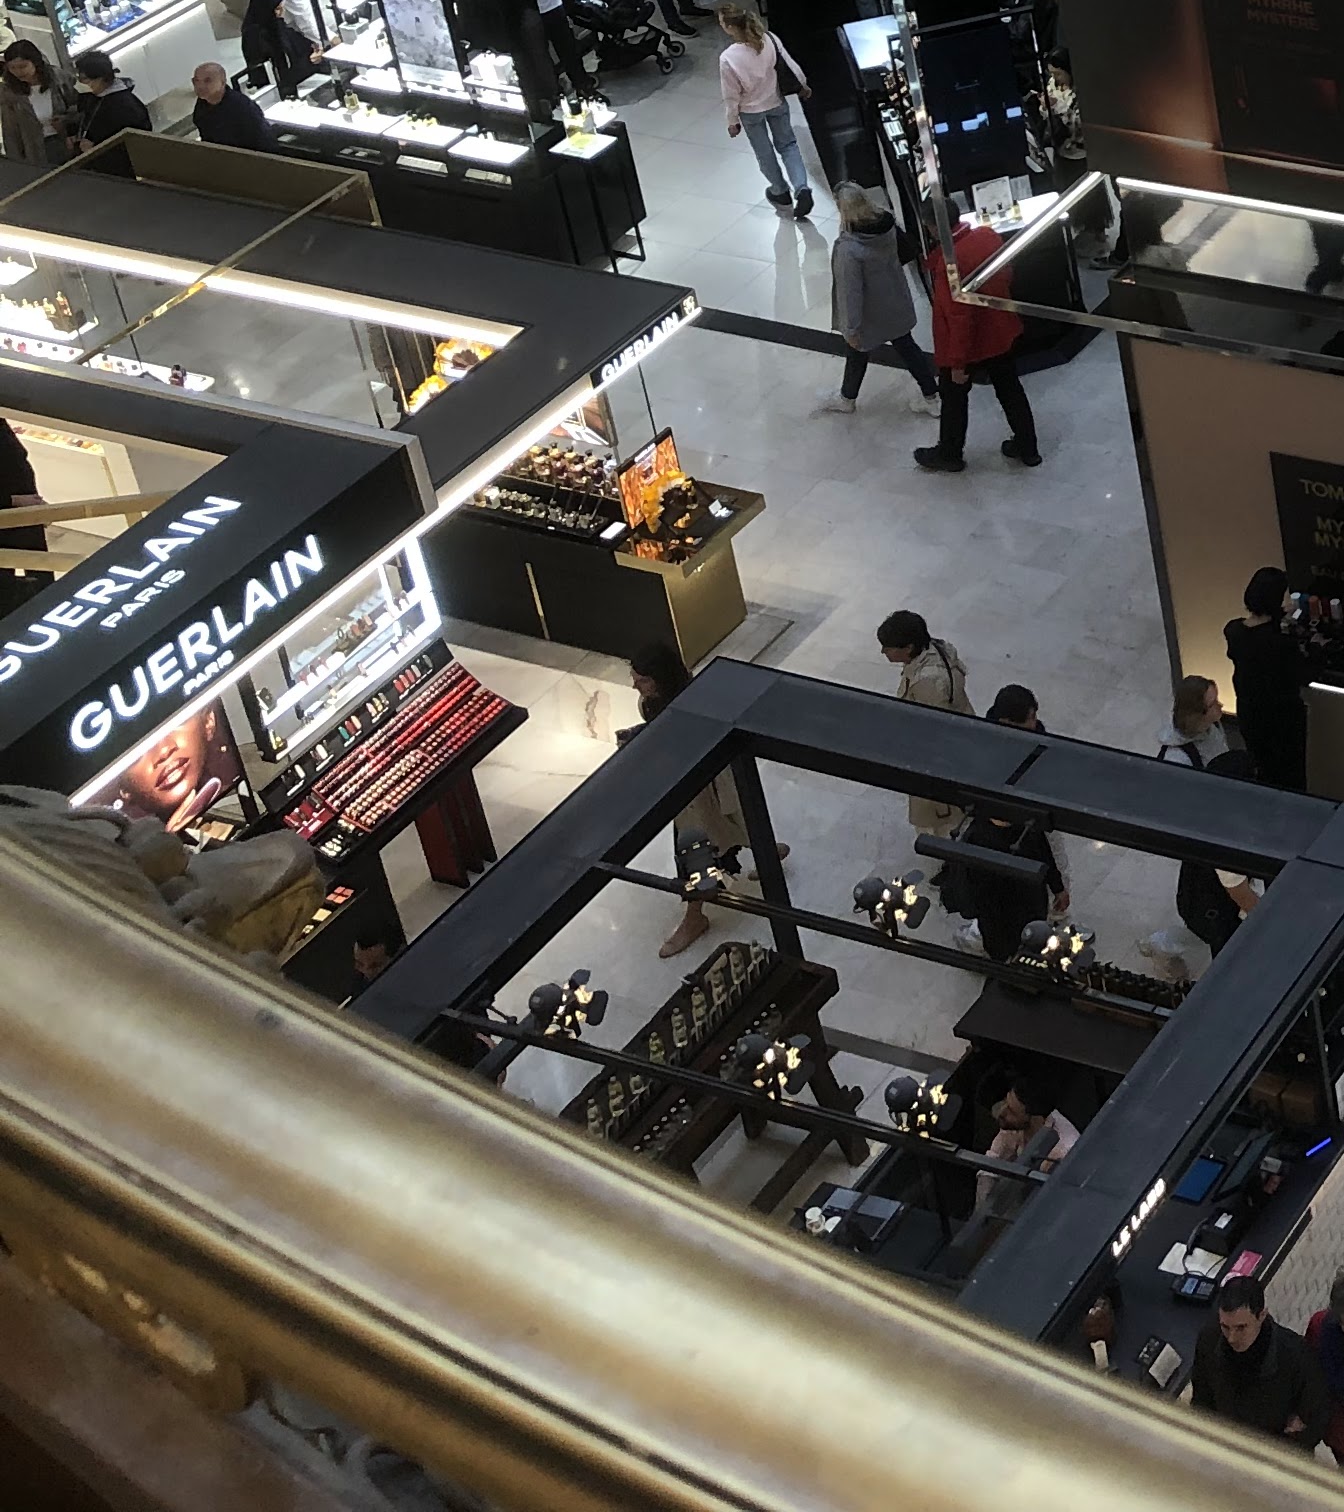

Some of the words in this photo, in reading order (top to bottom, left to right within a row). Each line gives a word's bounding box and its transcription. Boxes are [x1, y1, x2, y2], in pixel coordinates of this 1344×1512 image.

[600, 311, 680, 383] GUERLAIN
[101, 568, 187, 630] PARIS
[69, 532, 325, 751] GUERLAIN
[183, 648, 235, 697] PARIS
[1112, 1224, 1132, 1258] LE
[1130, 1177, 1166, 1231] LABO
